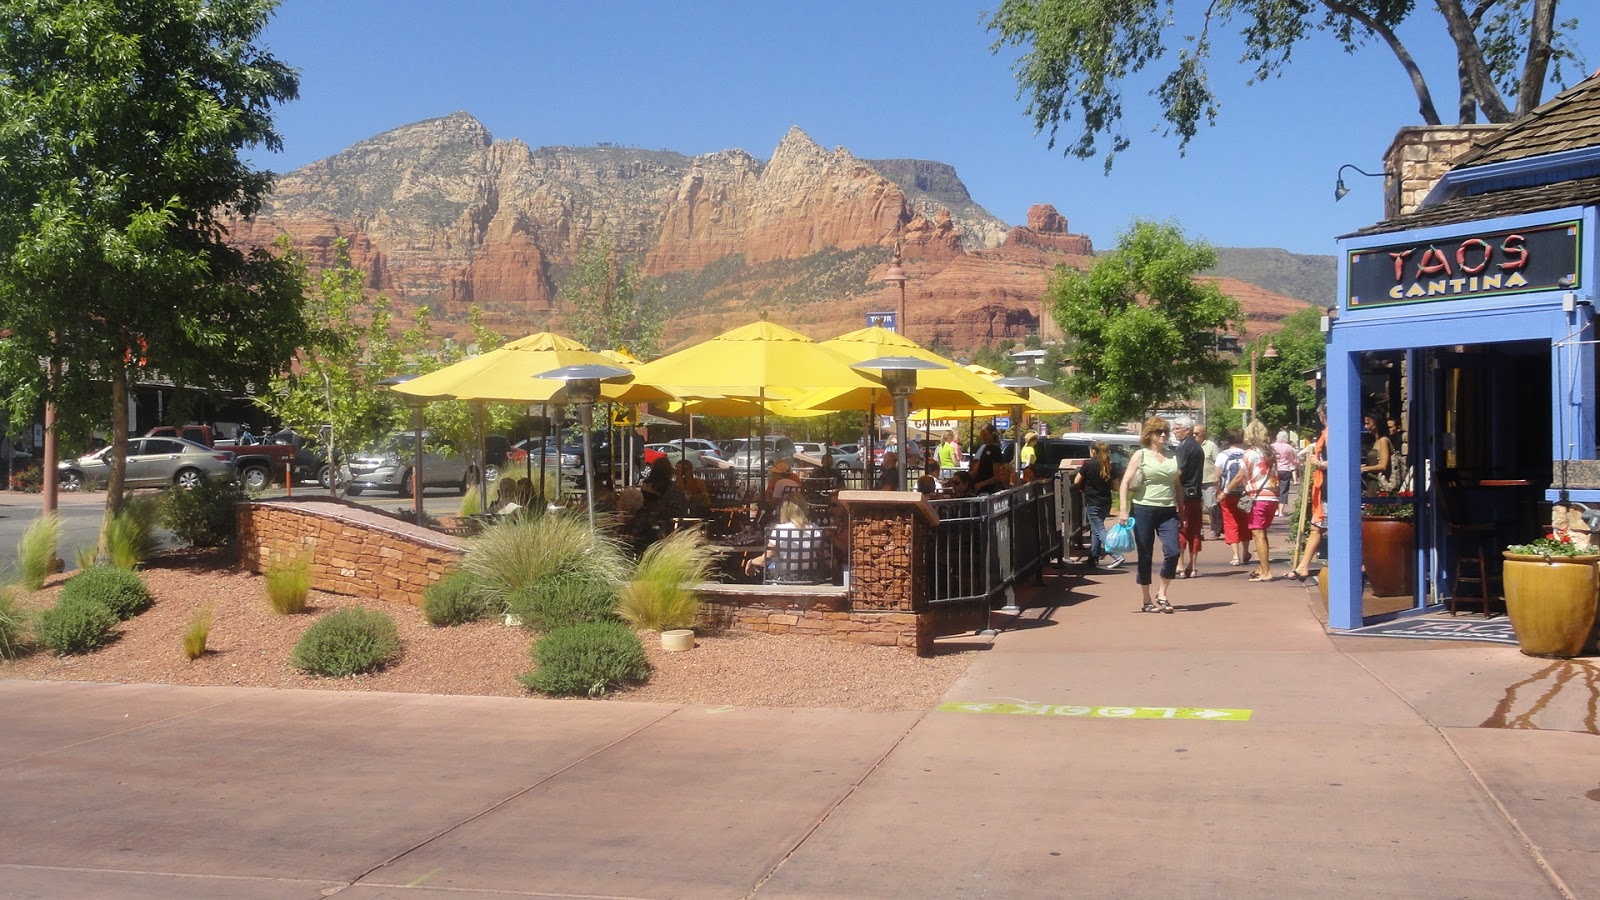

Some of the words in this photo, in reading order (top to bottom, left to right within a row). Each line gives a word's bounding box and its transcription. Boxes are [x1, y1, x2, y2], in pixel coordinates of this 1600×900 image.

[1389, 235, 1529, 280] TAOS
[1389, 272, 1528, 299] CANTINA
[1407, 622, 1515, 634] TAO
[1009, 703, 1178, 719] LOOK
